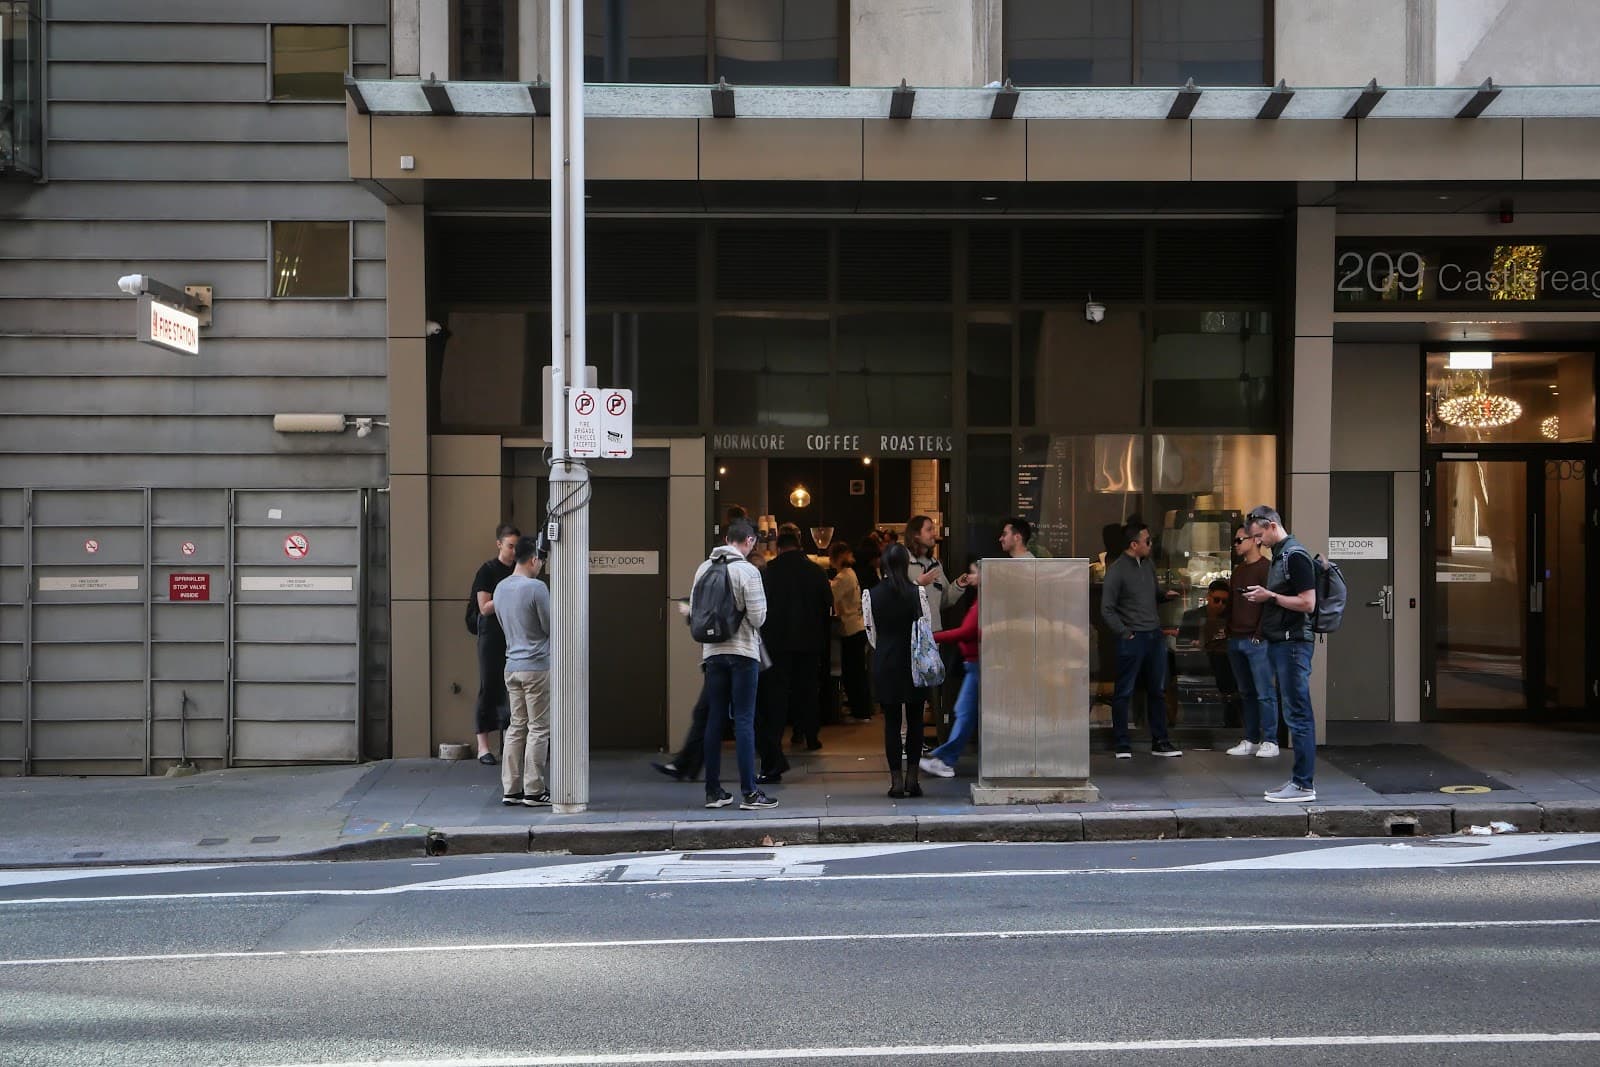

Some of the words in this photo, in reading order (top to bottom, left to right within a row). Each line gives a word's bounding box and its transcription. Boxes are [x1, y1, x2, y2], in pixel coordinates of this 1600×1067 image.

[1337, 252, 1424, 292] 209
[160, 317, 172, 340] FIRE
[173, 321, 197, 346] STATION
[713, 434, 785, 450] NORMCORE
[806, 434, 859, 450] COFFEE
[880, 435, 952, 451] ROASTERS
[1329, 540, 1346, 548] ETY
[1348, 540, 1374, 548] DOOR
[588, 556, 617, 565] AFETY
[618, 556, 645, 565] DOOR
